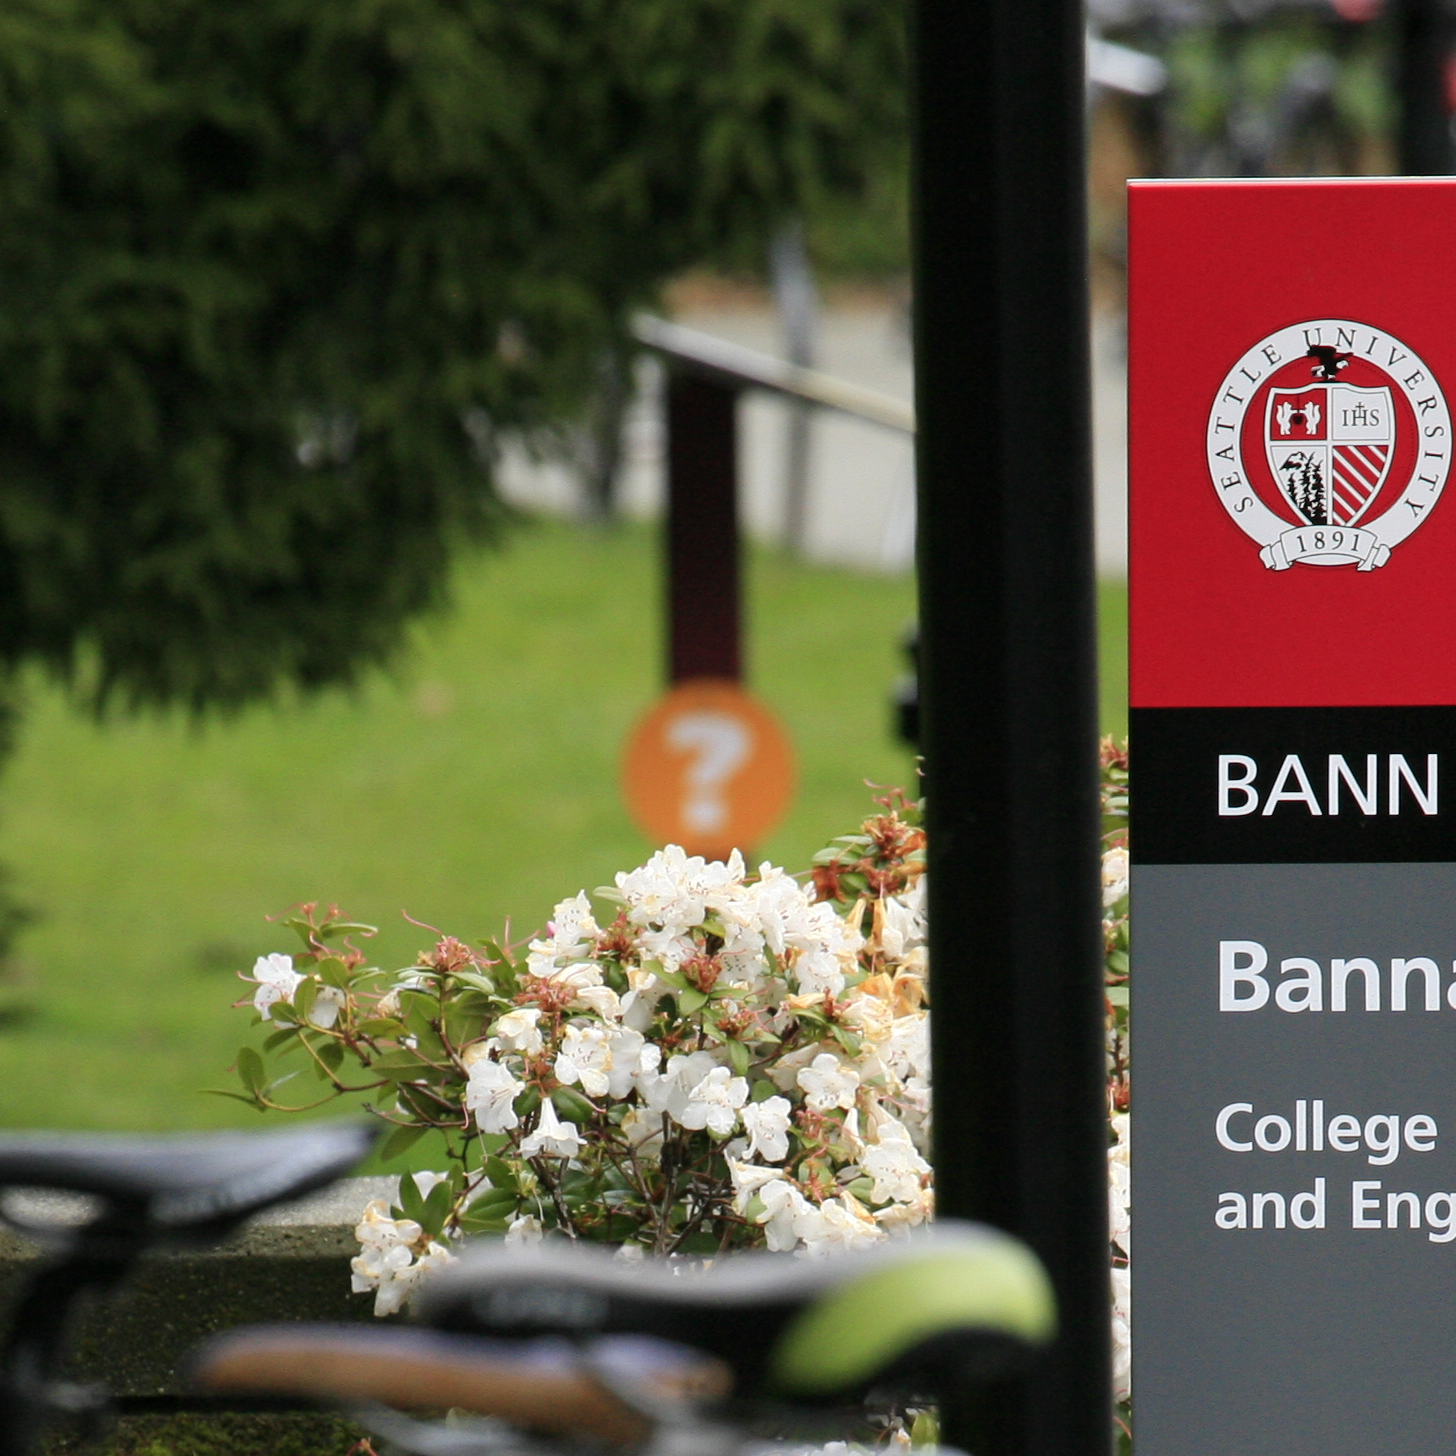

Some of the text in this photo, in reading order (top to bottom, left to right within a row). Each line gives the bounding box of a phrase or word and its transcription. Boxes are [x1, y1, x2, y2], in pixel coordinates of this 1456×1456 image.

[1213, 327, 1445, 519] SEATTLE UNIVERSITY
[1341, 405, 1380, 427] IHS
[1296, 531, 1360, 553] 1891
[1217, 752, 1439, 817] BANN
[1214, 1098, 1439, 1167] College
[1213, 1176, 1327, 1231] and
